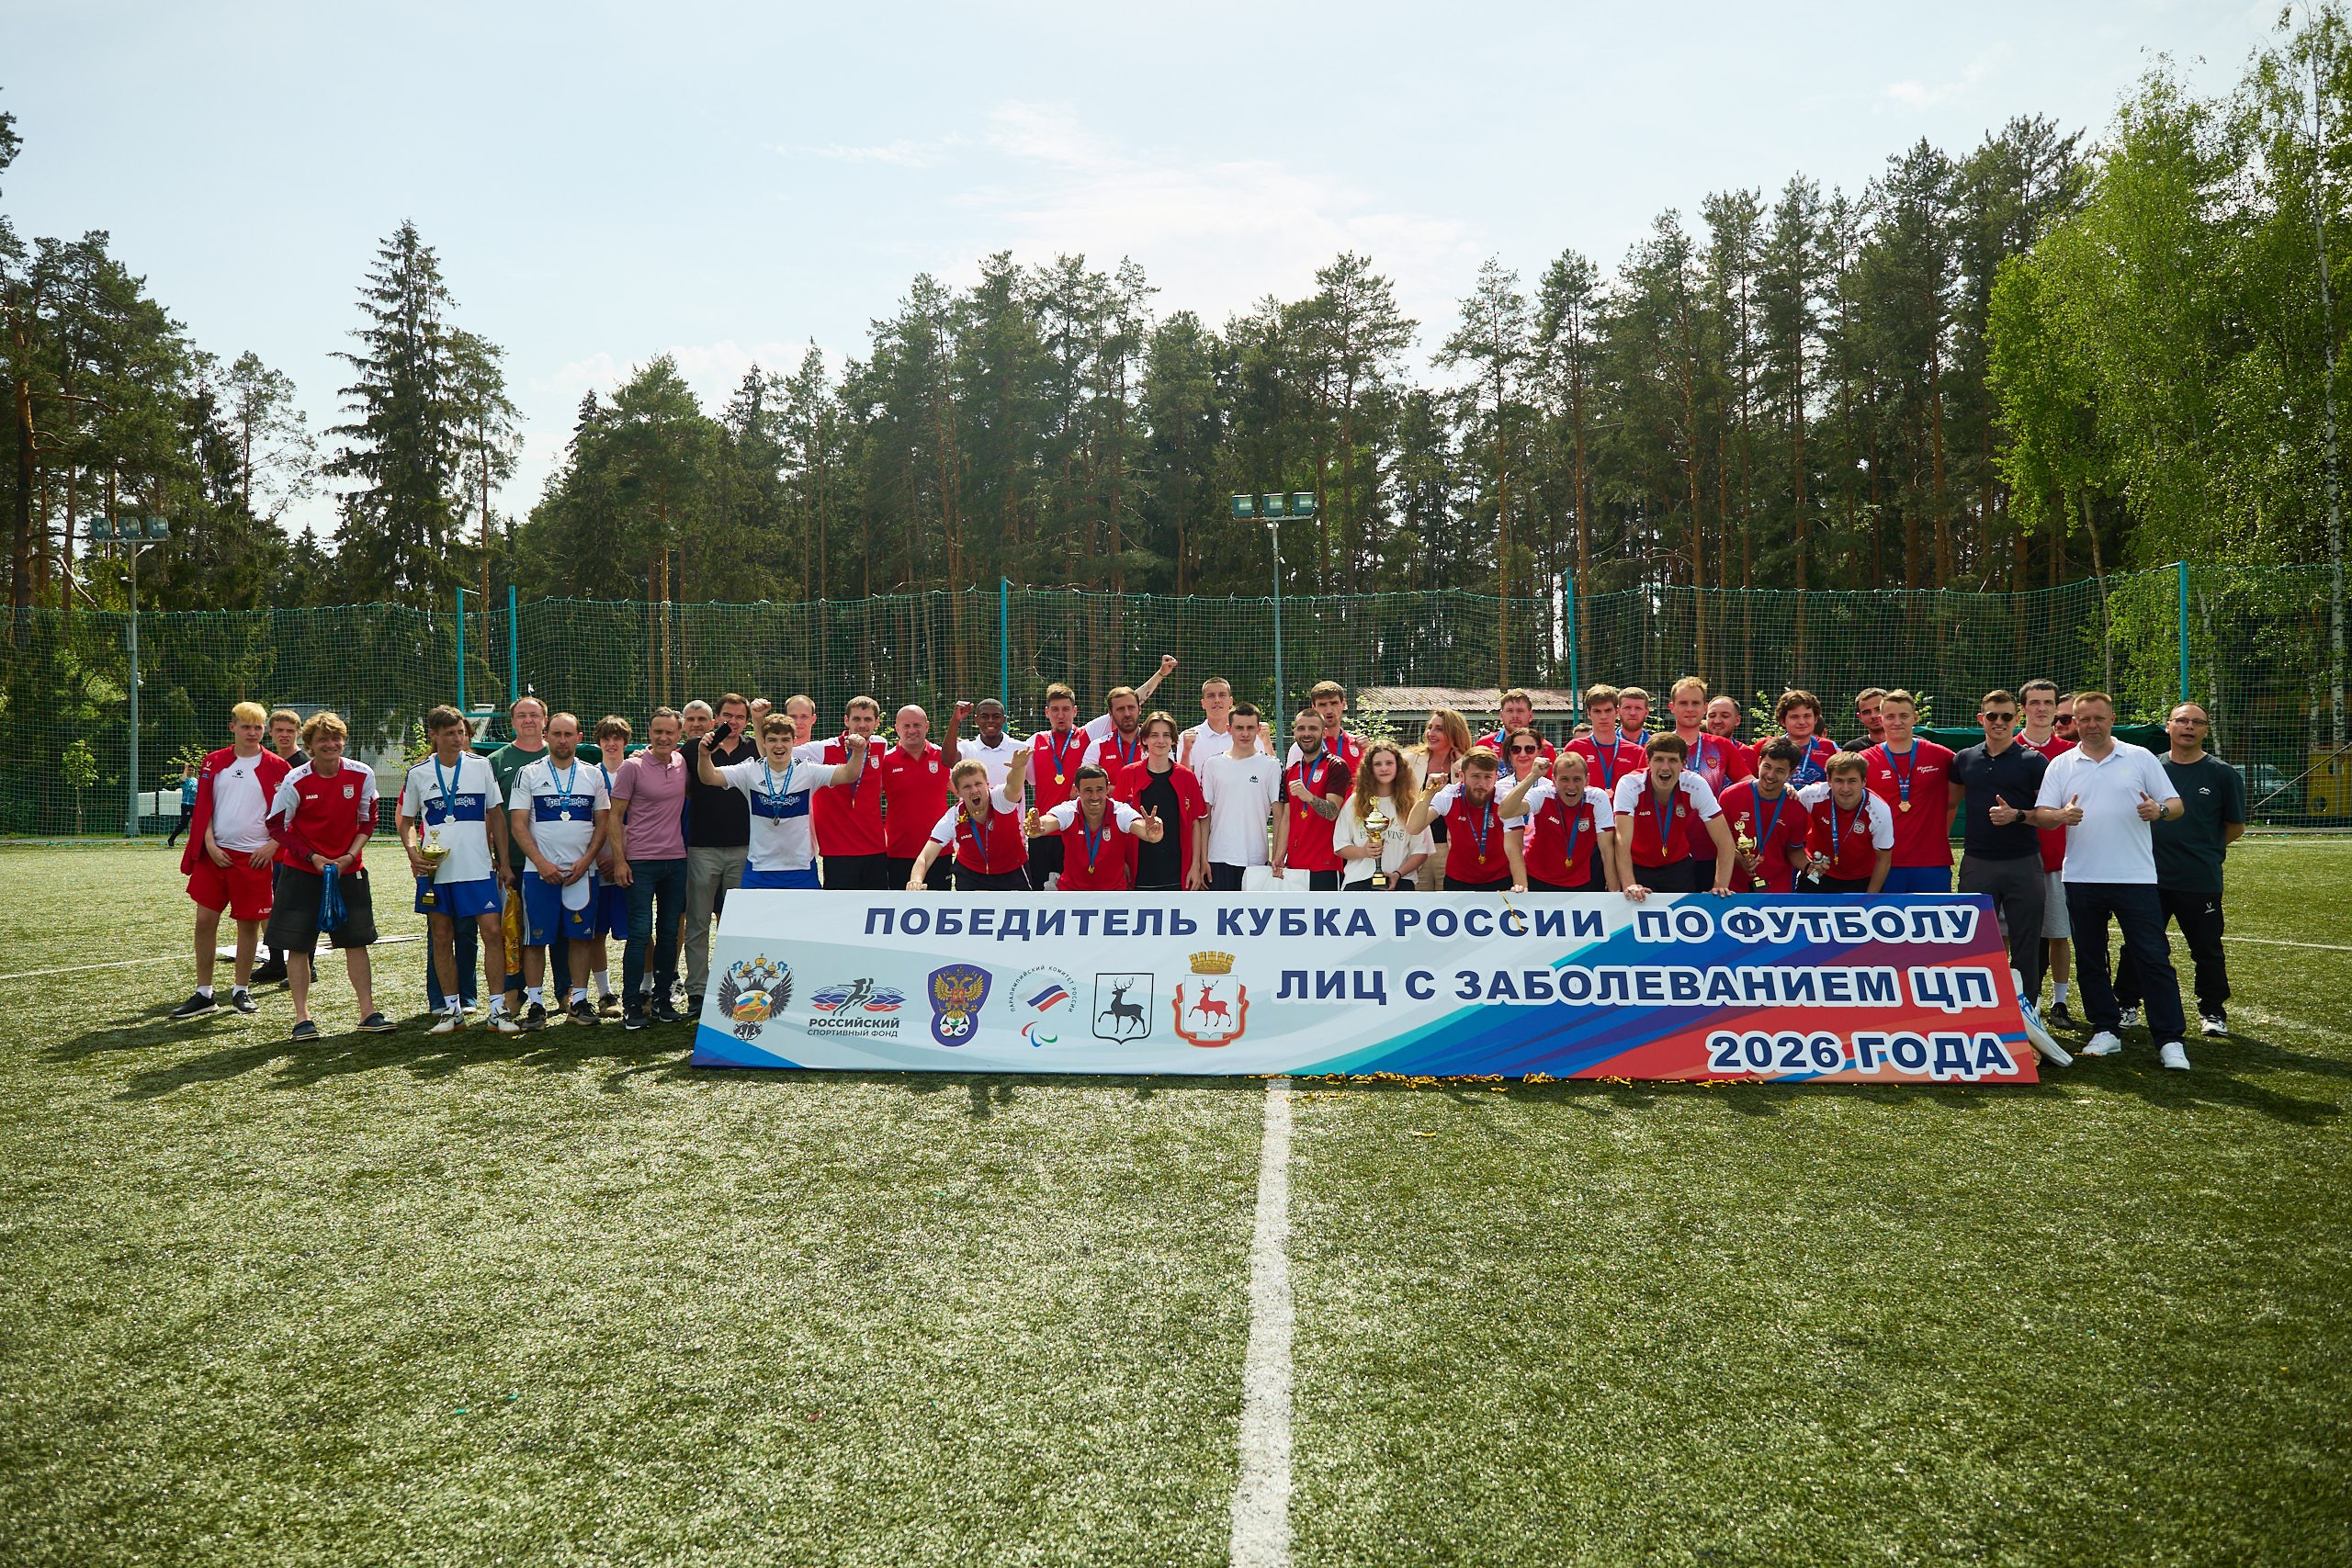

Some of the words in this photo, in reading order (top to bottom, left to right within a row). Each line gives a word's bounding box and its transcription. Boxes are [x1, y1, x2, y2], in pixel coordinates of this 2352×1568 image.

[865, 908, 1198, 942] ПОБЕДИТЕЛЬ
[1216, 908, 1378, 937] КУБКА
[1395, 908, 1605, 938] РОССИИ
[1636, 910, 1709, 938] ПО
[1726, 910, 1977, 940] ФУТБОЛУ
[1008, 964, 1045, 1012] ПАРАЛИМПИЙСКИЙ
[1048, 965, 1074, 985] КОМИТЕТ
[1068, 987, 1078, 1013] РОССИИ
[1275, 970, 1388, 1007] ЛИЦ
[1404, 970, 1437, 1000] С
[1453, 970, 1897, 1001] ЗАБОЛЕВАНИЕМ
[1913, 971, 1995, 1009] ЦП
[808, 1017, 900, 1028] РОССИЙСКИЙ
[1712, 1035, 1840, 1068] 2026
[1856, 1036, 2013, 1077] ГОДА
